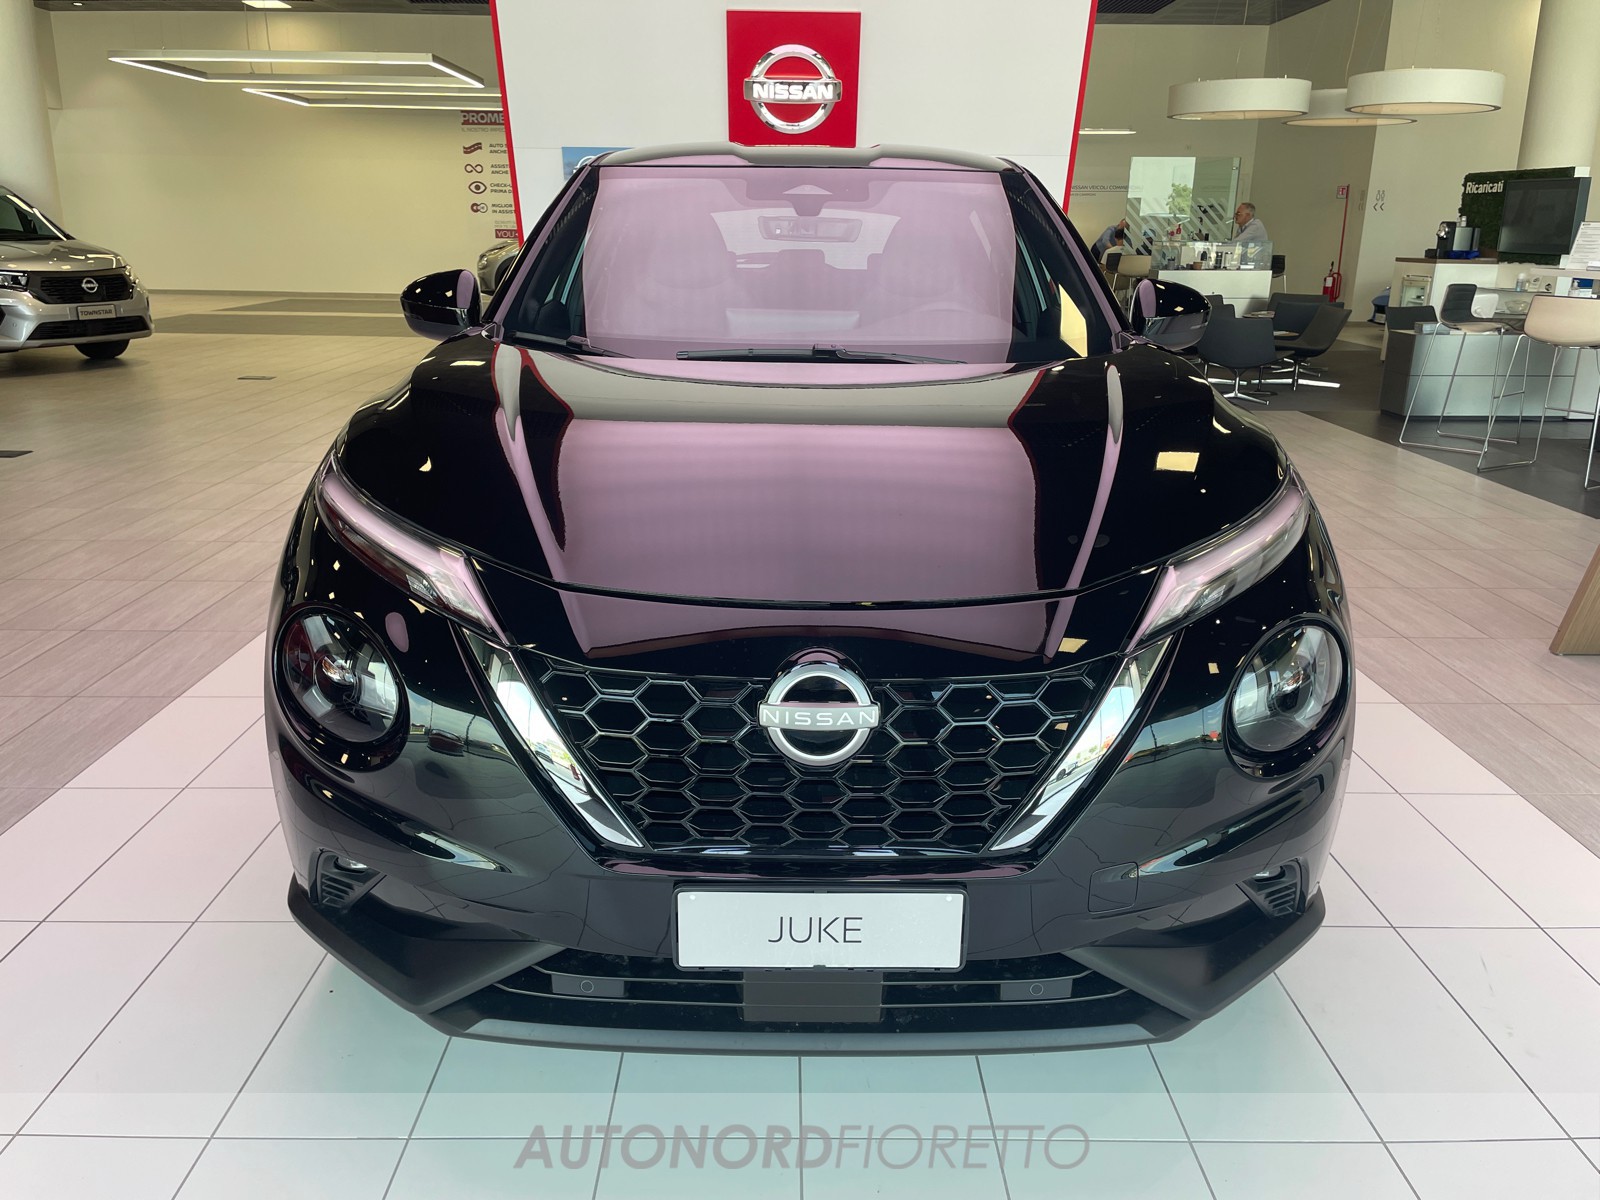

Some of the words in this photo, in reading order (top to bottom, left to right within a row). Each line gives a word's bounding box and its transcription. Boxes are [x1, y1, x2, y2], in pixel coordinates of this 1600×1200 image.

[752, 83, 834, 100] NISSAN
[1465, 180, 1504, 194] Ricaricati
[763, 709, 876, 726] NISSAN
[768, 916, 863, 943] JUKE
